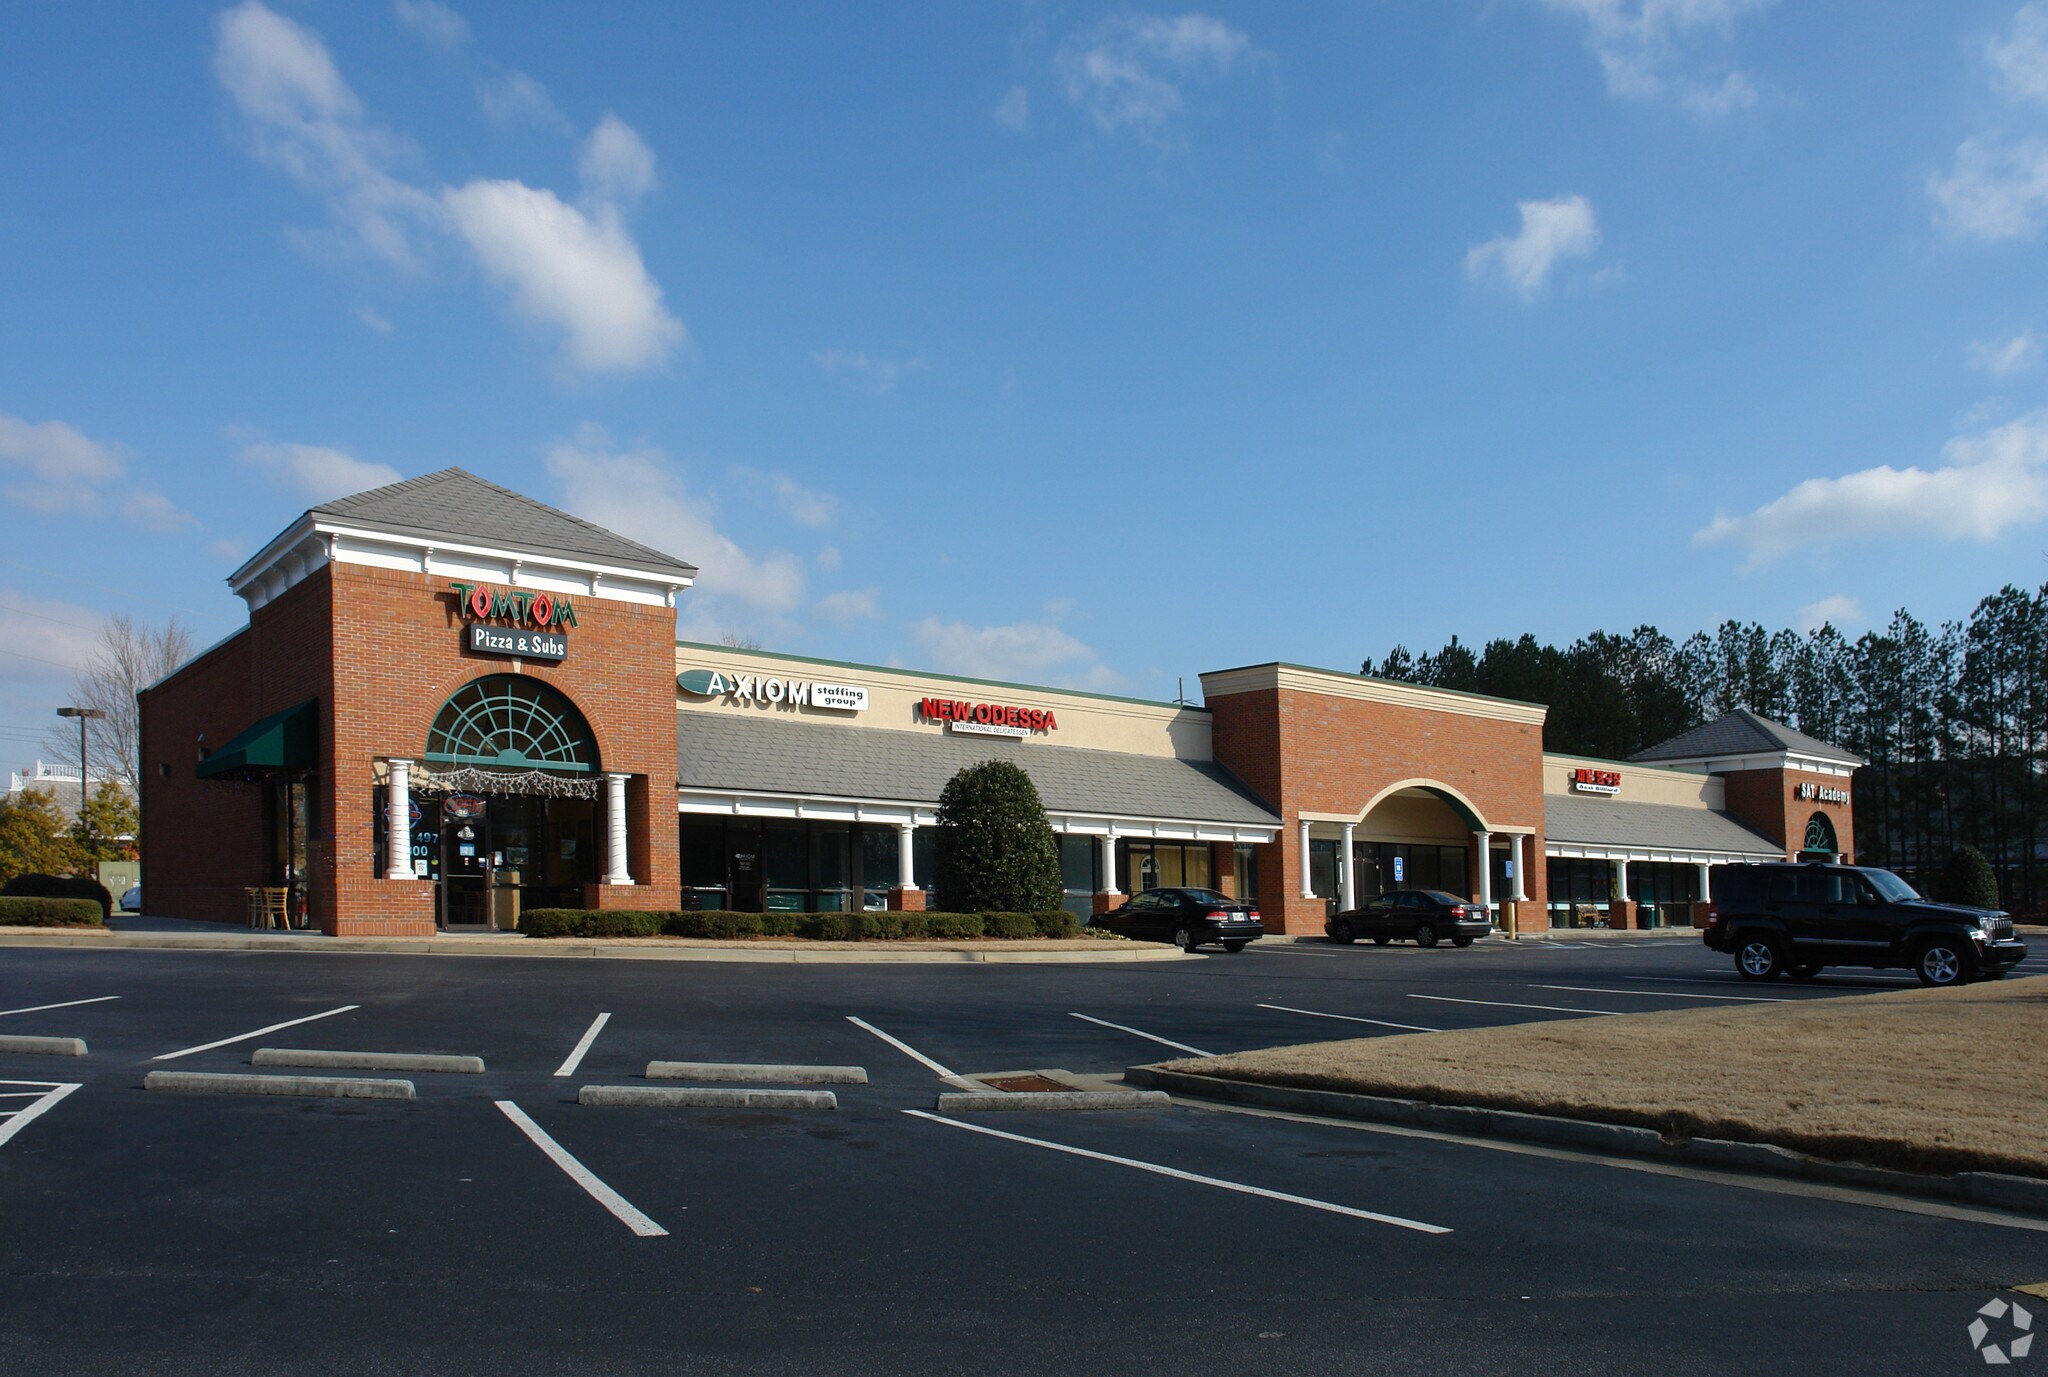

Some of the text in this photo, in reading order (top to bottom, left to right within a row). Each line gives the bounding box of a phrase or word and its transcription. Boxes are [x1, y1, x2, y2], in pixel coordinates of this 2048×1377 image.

[450, 582, 580, 628] TOMTOM
[475, 628, 565, 656] Pizza & Subs
[706, 672, 808, 706] AXIOM
[817, 686, 863, 700] staffing
[824, 697, 856, 707] group
[922, 697, 1058, 730] NEW ODESSA
[954, 723, 1030, 736] INTERNATIONAL DELICATESSEN
[1801, 782, 1850, 805] SAT Academy
[416, 832, 439, 844] 497
